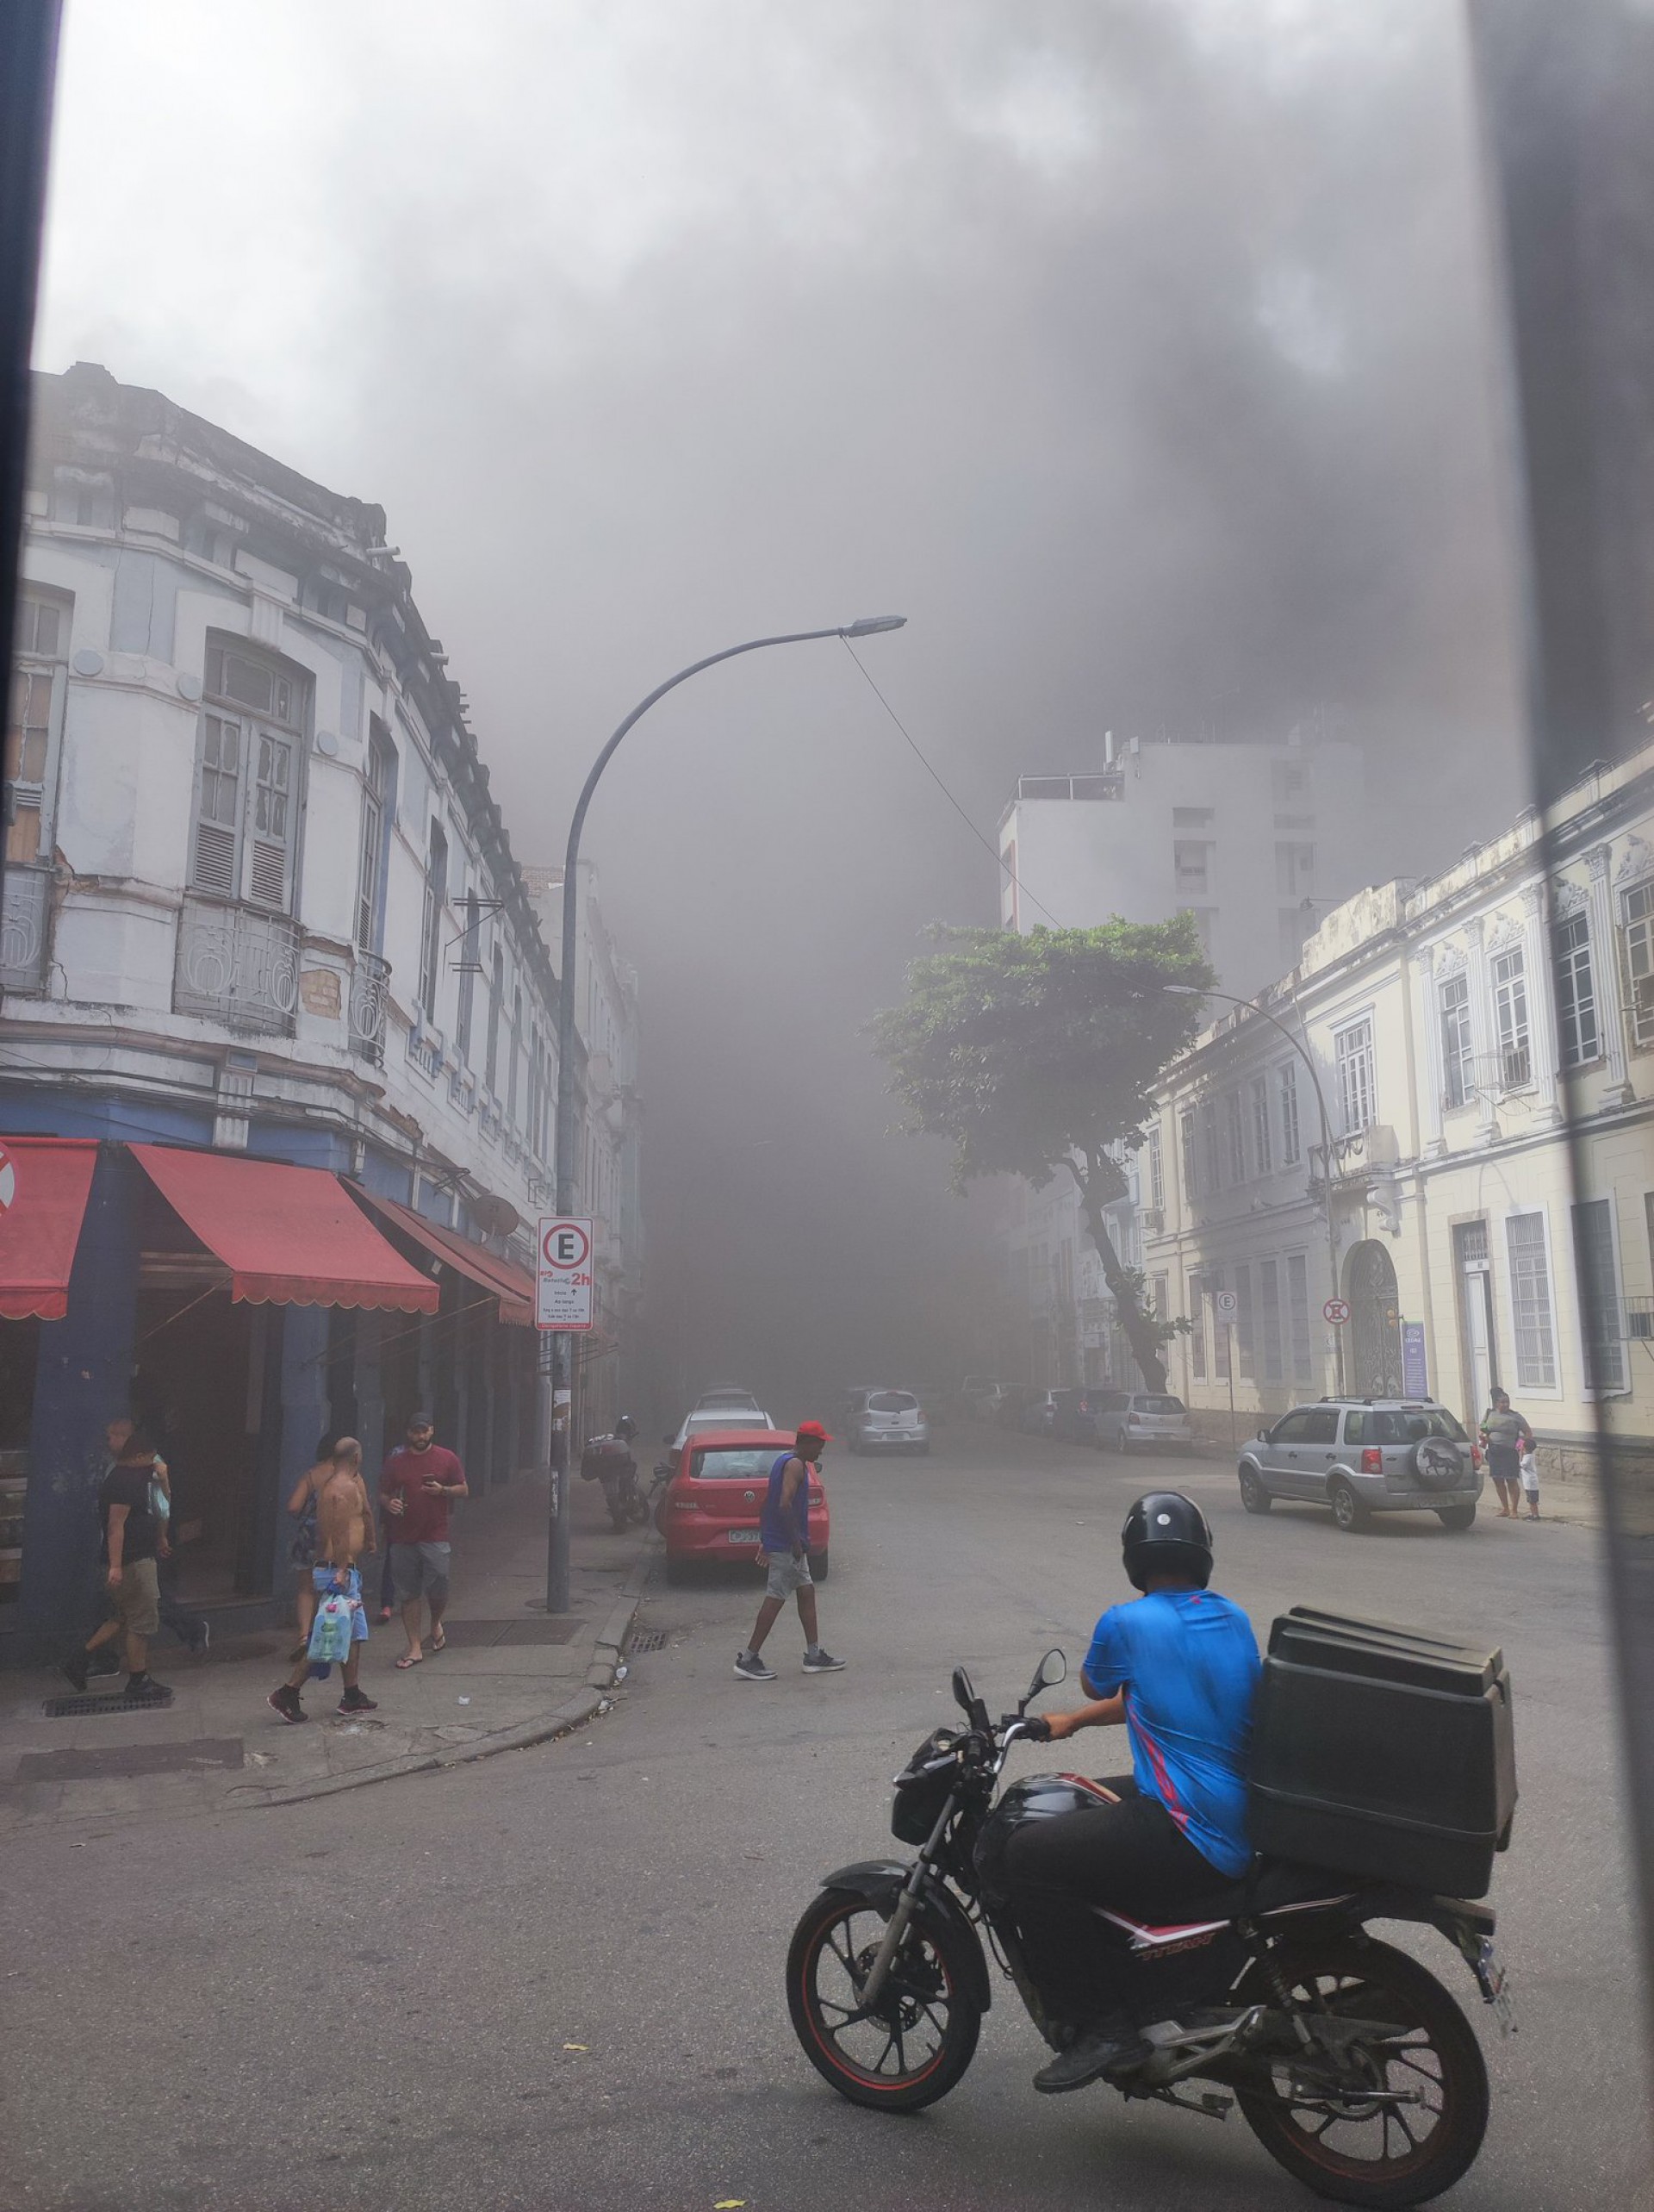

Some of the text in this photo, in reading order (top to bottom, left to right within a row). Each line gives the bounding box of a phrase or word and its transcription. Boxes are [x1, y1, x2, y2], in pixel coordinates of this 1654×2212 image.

[558, 1234, 574, 1259] E
[571, 1273, 592, 1286] 2h
[1224, 1297, 1230, 1306] E
